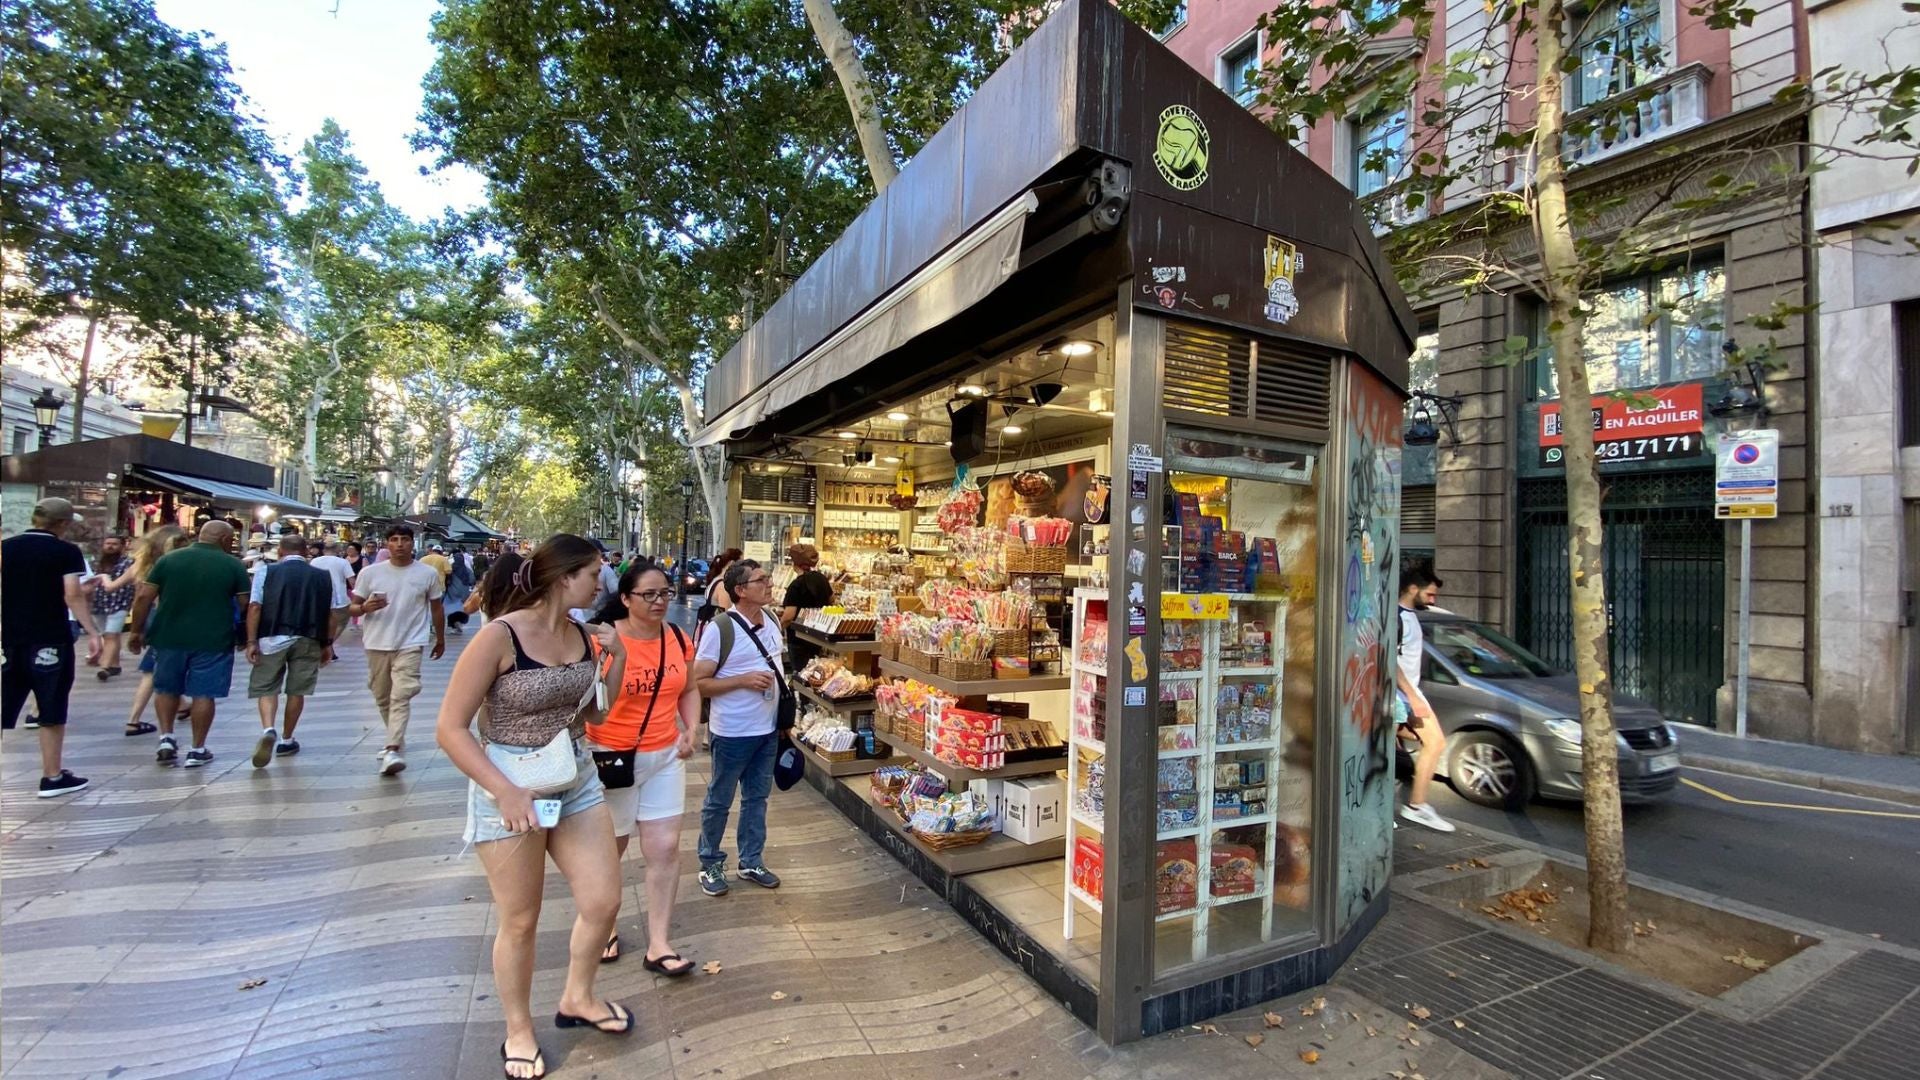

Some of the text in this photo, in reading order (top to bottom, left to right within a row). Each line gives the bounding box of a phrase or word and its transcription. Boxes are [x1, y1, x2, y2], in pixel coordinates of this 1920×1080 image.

[1160, 106, 1209, 142] LOVE TECHNO
[1154, 154, 1207, 189] HATE RACISM
[1626, 399, 1676, 414] LAL
[1605, 418, 1623, 430] EN
[1627, 410, 1699, 427] ALQUILER
[1634, 438, 1658, 455] 71
[1664, 435, 1690, 452] 71
[1218, 552, 1238, 561] BARÇA
[1161, 597, 1185, 616] Saffron
